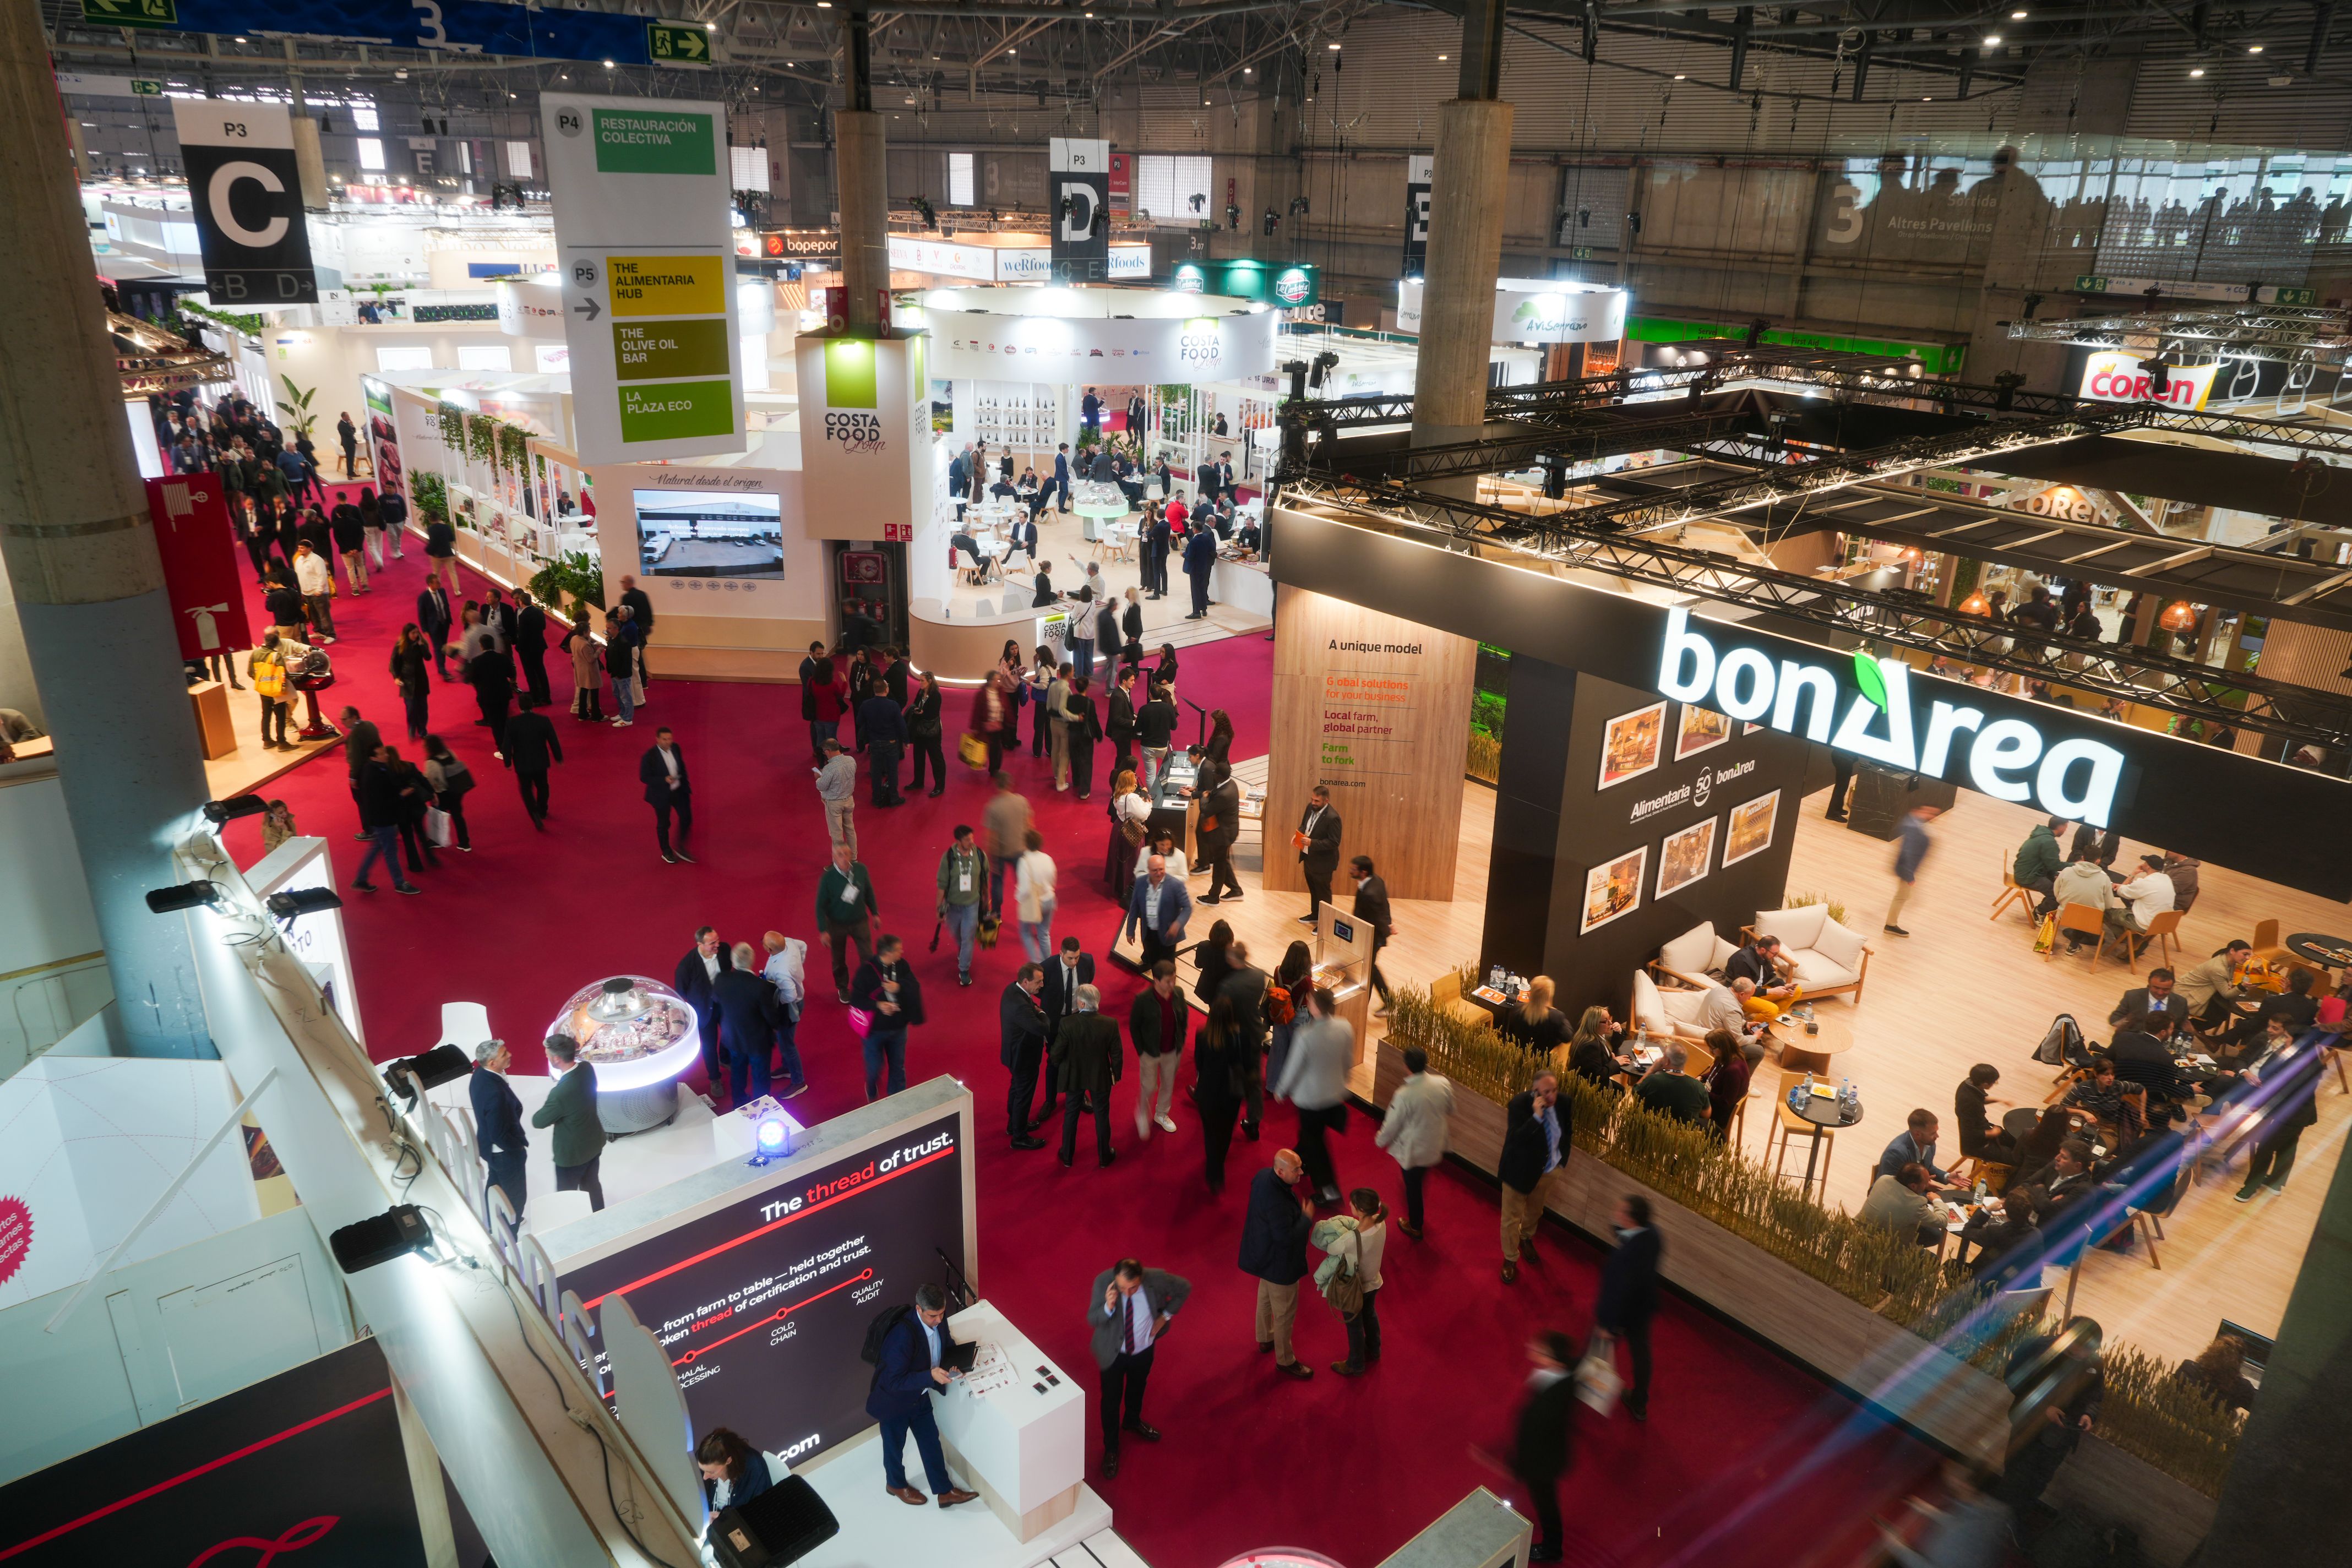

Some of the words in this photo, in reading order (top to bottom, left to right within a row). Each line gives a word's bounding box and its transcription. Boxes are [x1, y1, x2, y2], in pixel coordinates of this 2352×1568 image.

[412, 0, 448, 48] 3
[559, 115, 579, 129] P4
[601, 117, 696, 133] RESTAURACIÓN
[224, 122, 247, 137] P3
[602, 132, 672, 145] COLECTIVA
[1074, 155, 1086, 165] P3
[1114, 160, 1120, 168] P3
[1424, 170, 1432, 178] P3
[208, 161, 290, 247] C
[1947, 193, 1997, 208] Sortida
[1061, 182, 1100, 242] D
[1827, 184, 1864, 243] 3
[1887, 215, 1927, 230] Altres
[1929, 217, 1992, 232] Pavellons
[787, 238, 838, 253] bopepor
[575, 268, 595, 281] P5
[614, 263, 638, 274] THE
[1059, 261, 1072, 279] C
[1088, 262, 1098, 279] E
[225, 274, 248, 298] B
[277, 274, 299, 298] D
[616, 275, 695, 286] ALIMENTARIA
[617, 288, 643, 299] HUB
[620, 328, 644, 339] THE
[622, 340, 656, 351] OLIVE
[658, 339, 678, 349] OIL
[1180, 335, 1219, 348] COSTA
[1791, 336, 1806, 345] First
[1807, 338, 1820, 347] Aid
[623, 352, 647, 363] BAR
[1180, 347, 1219, 361] FOOD
[626, 392, 642, 402] LA
[627, 402, 666, 414] PLAZA
[668, 400, 692, 411] ECO
[914, 404, 926, 421] COSTA
[825, 412, 881, 428] COSTA
[916, 417, 926, 434] FOOD
[826, 427, 880, 441] FOOD
[843, 434, 886, 455] Group
[649, 473, 696, 486] Natural
[695, 475, 722, 486] desde
[723, 476, 734, 487] el
[733, 478, 764, 491] origen
[1044, 622, 1066, 632] COSTA
[1044, 628, 1066, 639] FOOD
[1329, 639, 1337, 650] A
[1340, 640, 1381, 654] unique
[1384, 643, 1422, 654] model
[1362, 679, 1408, 690] solutions
[1326, 689, 1340, 698] for
[1341, 692, 1362, 700] your
[1364, 691, 1406, 702] business
[1324, 710, 1351, 720] Local
[1353, 711, 1378, 722] farm,
[1658, 603, 2125, 830] bonArea
[1323, 722, 1355, 733] global
[1357, 725, 1392, 734] partner
[1322, 743, 1348, 753] Farm
[1321, 755, 1332, 764] to
[1334, 755, 1354, 765] fork
[1319, 778, 1366, 787] bonarea.com
[1630, 784, 1691, 820] Alimentaria
[1716, 759, 1755, 785] bonArea
[760, 1196, 802, 1222] The
[806, 1161, 874, 1204] thread
[880, 1150, 901, 1172] of
[903, 1132, 954, 1162] trust.
[663, 1313, 695, 1333] from
[696, 1298, 727, 1318] farm
[728, 1290, 741, 1303] to
[742, 1274, 774, 1297] table
[789, 1256, 815, 1276] held
[816, 1235, 865, 1262] together
[691, 1307, 733, 1333] thread
[734, 1299, 748, 1313] of
[749, 1269, 818, 1306] certification
[818, 1257, 841, 1275] and
[842, 1245, 872, 1264] trust.
[851, 1278, 884, 1299] QUALITY
[856, 1289, 880, 1305] AUDIT
[771, 1321, 795, 1337] COLD
[770, 1329, 797, 1346] CHAIN
[677, 1364, 707, 1381] HALAL
